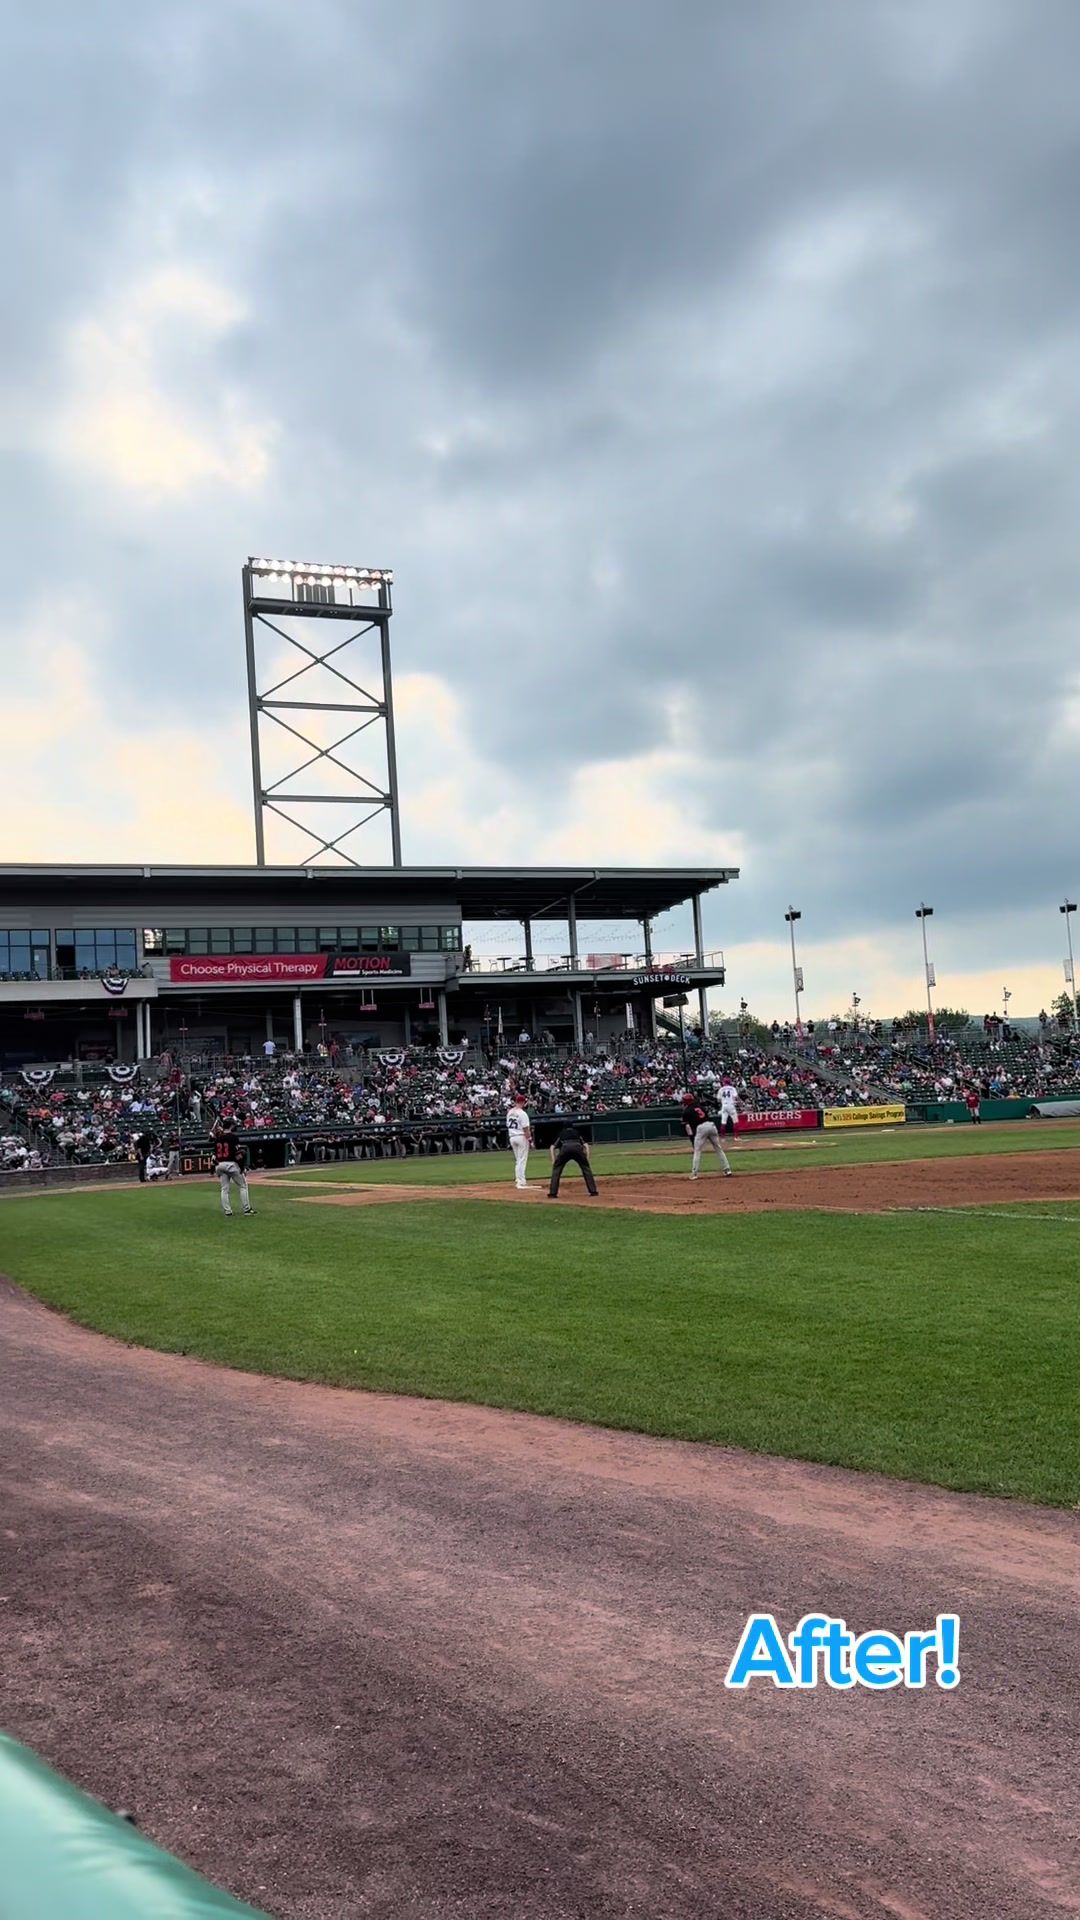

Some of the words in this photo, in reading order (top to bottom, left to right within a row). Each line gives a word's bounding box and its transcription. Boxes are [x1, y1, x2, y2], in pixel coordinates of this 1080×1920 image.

[180, 963, 225, 975] Choose
[227, 963, 272, 976] Physical
[273, 962, 318, 975] Therapy
[334, 956, 391, 970] MOTION
[361, 968, 379, 976] Sports
[633, 974, 663, 986] SUNSET
[670, 974, 690, 984] DECK
[747, 1110, 802, 1122] RUTGERS
[508, 1118, 518, 1129] 25
[216, 1142, 229, 1158] 33
